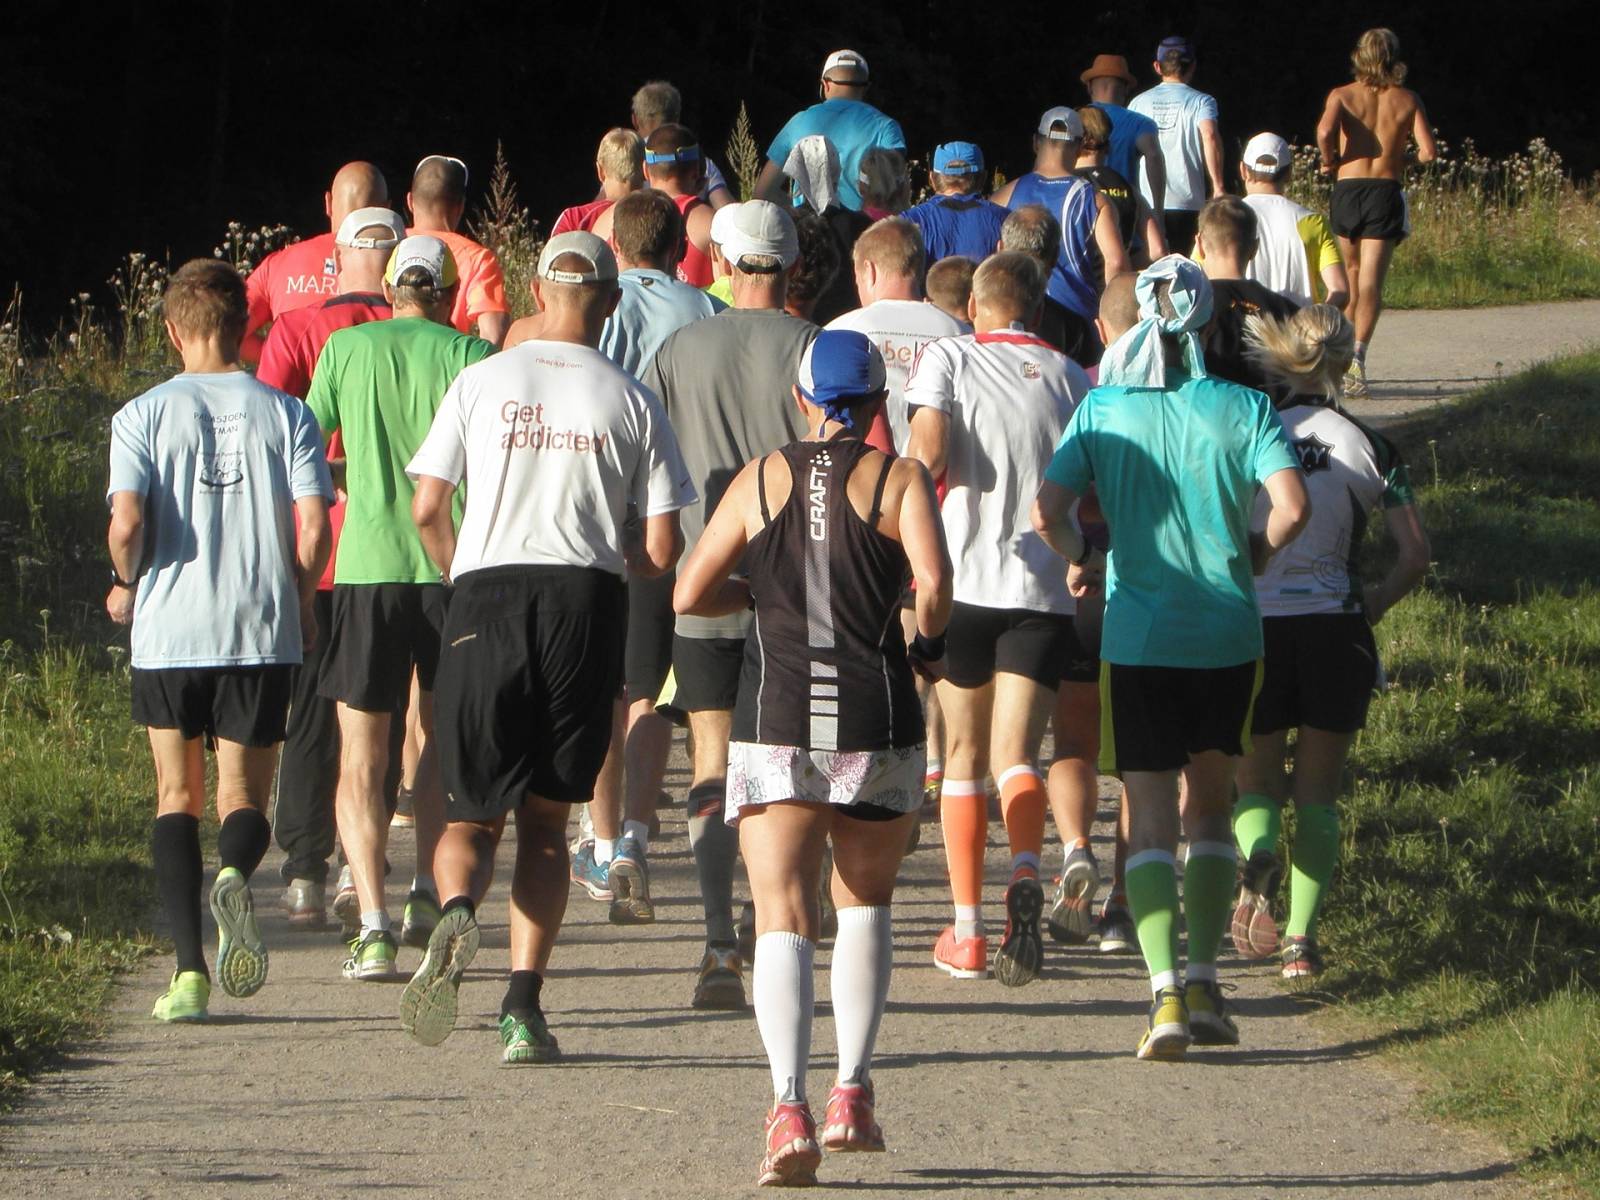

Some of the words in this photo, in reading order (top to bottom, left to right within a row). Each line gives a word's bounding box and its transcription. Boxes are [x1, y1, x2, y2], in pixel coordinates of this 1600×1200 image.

[501, 400, 543, 424] Get
[501, 424, 608, 454] addicted
[809, 466, 828, 541] CRAFT
